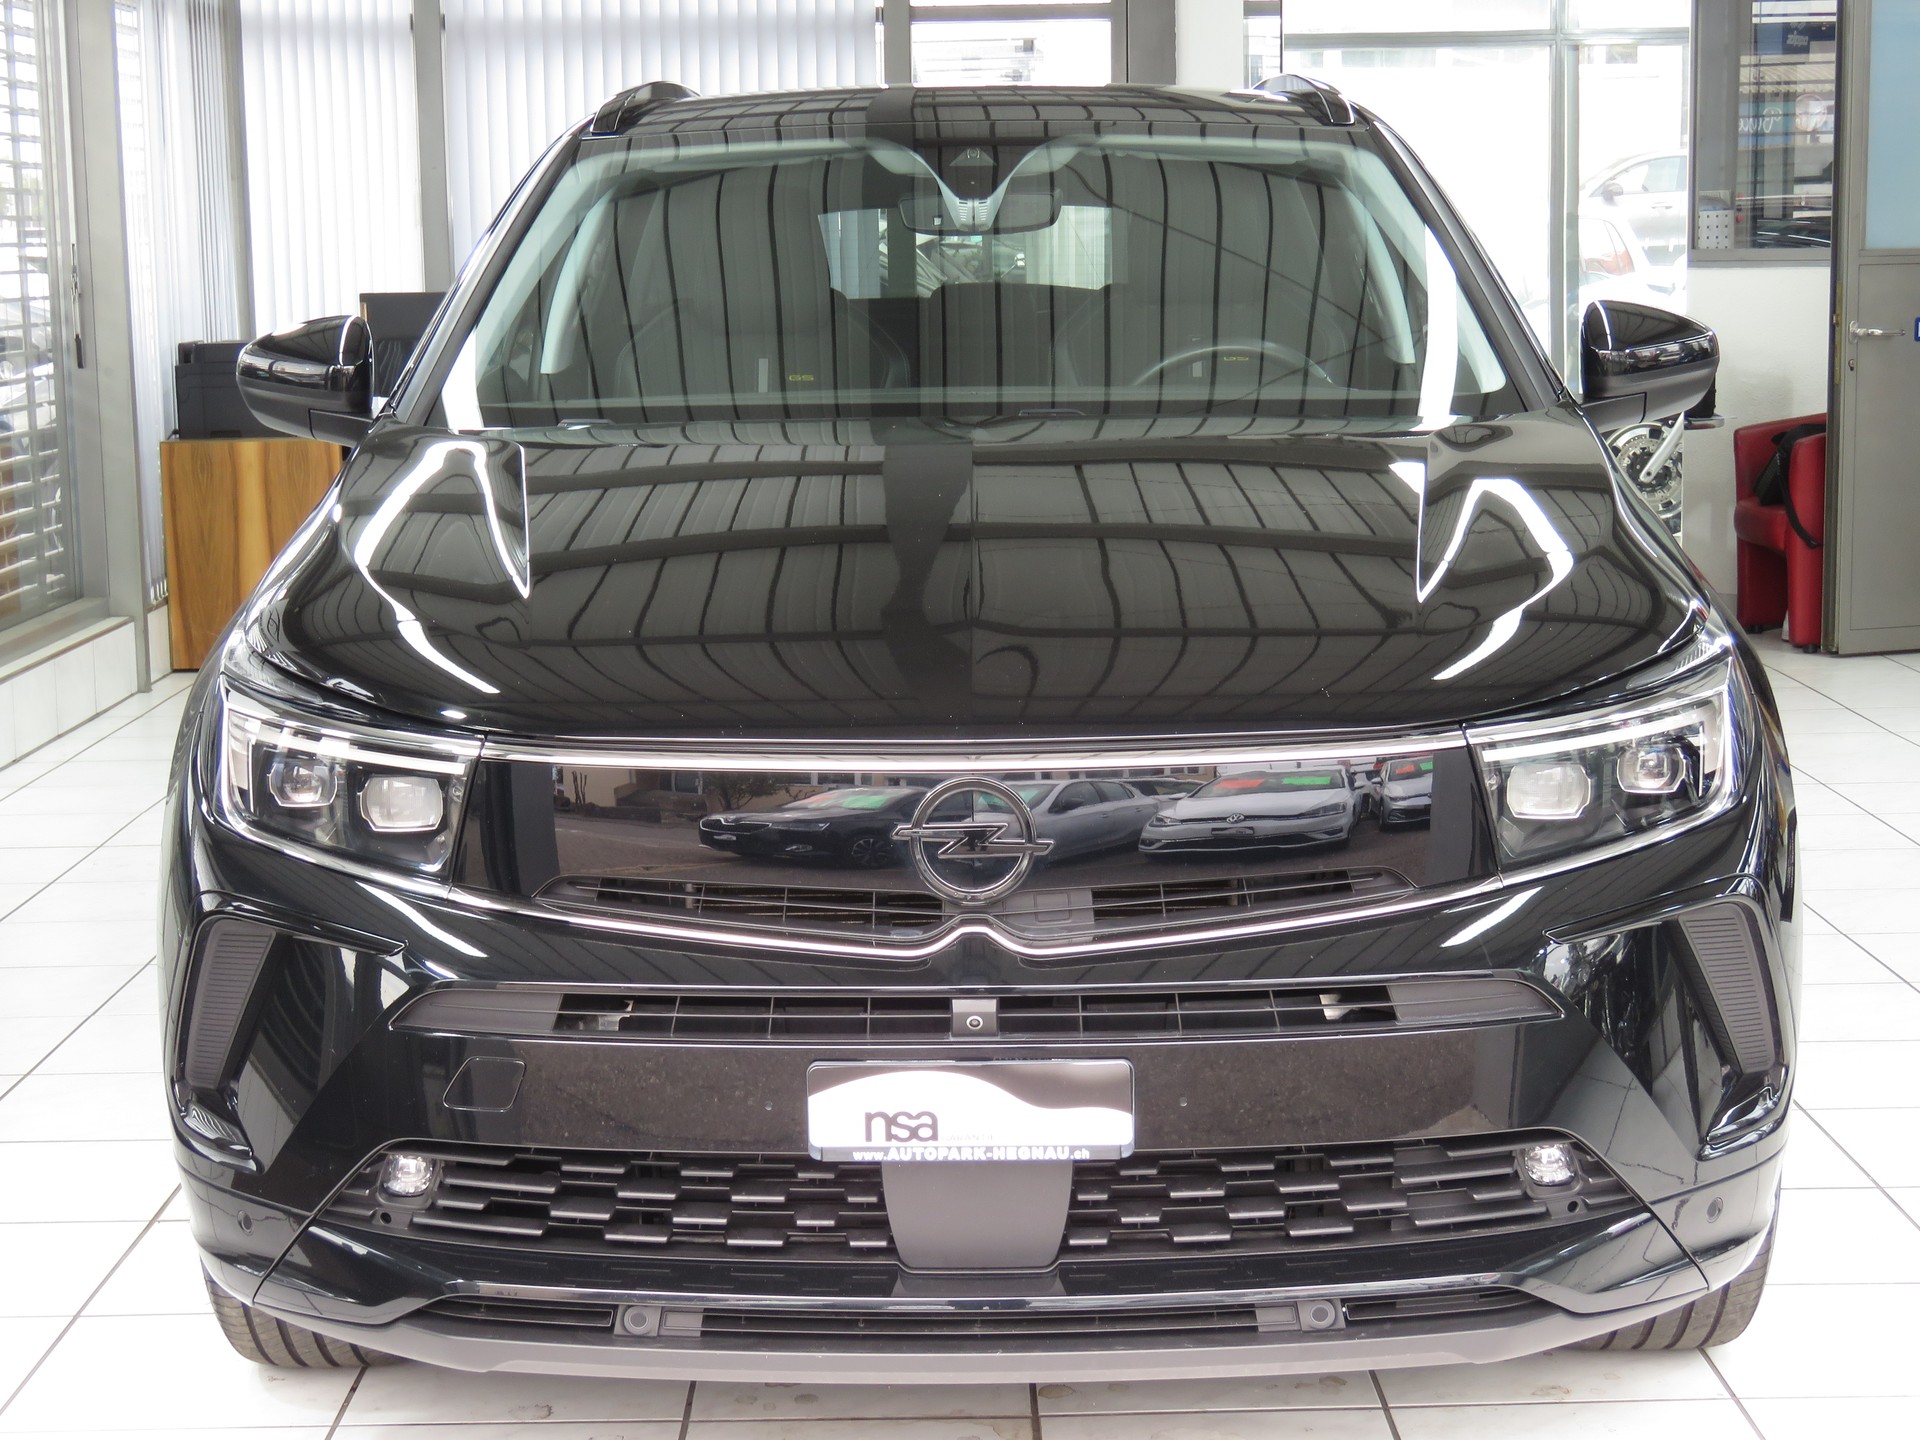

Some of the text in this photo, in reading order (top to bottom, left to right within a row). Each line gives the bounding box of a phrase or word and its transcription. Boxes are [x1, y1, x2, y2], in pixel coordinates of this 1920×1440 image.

[865, 1111, 994, 1142] nsa ARANTI
[852, 1146, 1090, 1161] www.AUTOPARK-HEGNAU.ch
